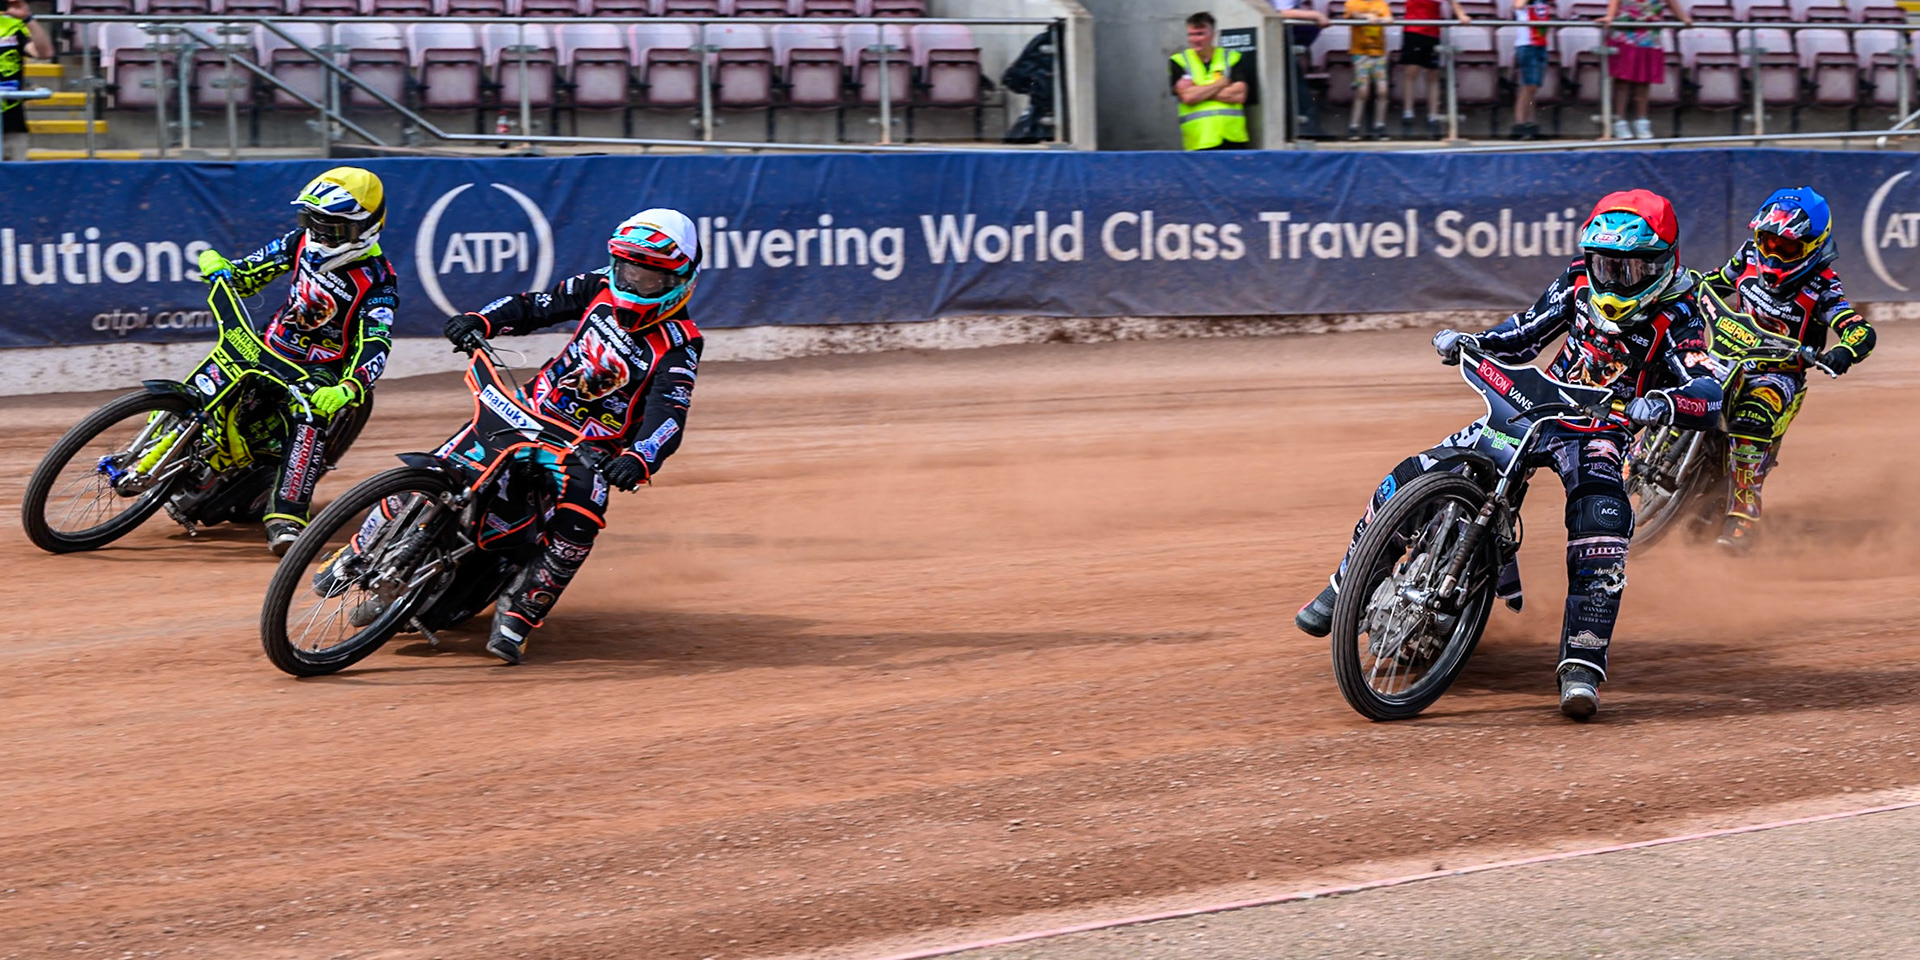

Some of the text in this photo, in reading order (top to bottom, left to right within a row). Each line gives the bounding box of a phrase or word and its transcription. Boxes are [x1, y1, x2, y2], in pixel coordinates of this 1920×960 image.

[1, 227, 213, 285] lutions
[440, 231, 529, 274] ATPI
[697, 207, 1582, 281] livering World Class Travel Soluti
[1740, 284, 1781, 316] CHAMPIONSHIP
[92, 308, 214, 336] atpi.com
[1733, 327, 1759, 347] FINCH
[589, 313, 632, 355] CHAMPIONSHIP
[629, 354, 649, 371] 2025
[482, 388, 521, 424] marluk
[548, 387, 589, 420] NSSC
[1480, 362, 1534, 411] BOLTON VANS
[302, 440, 324, 494] NEW ROAD
[1601, 508, 1618, 516] AGC
